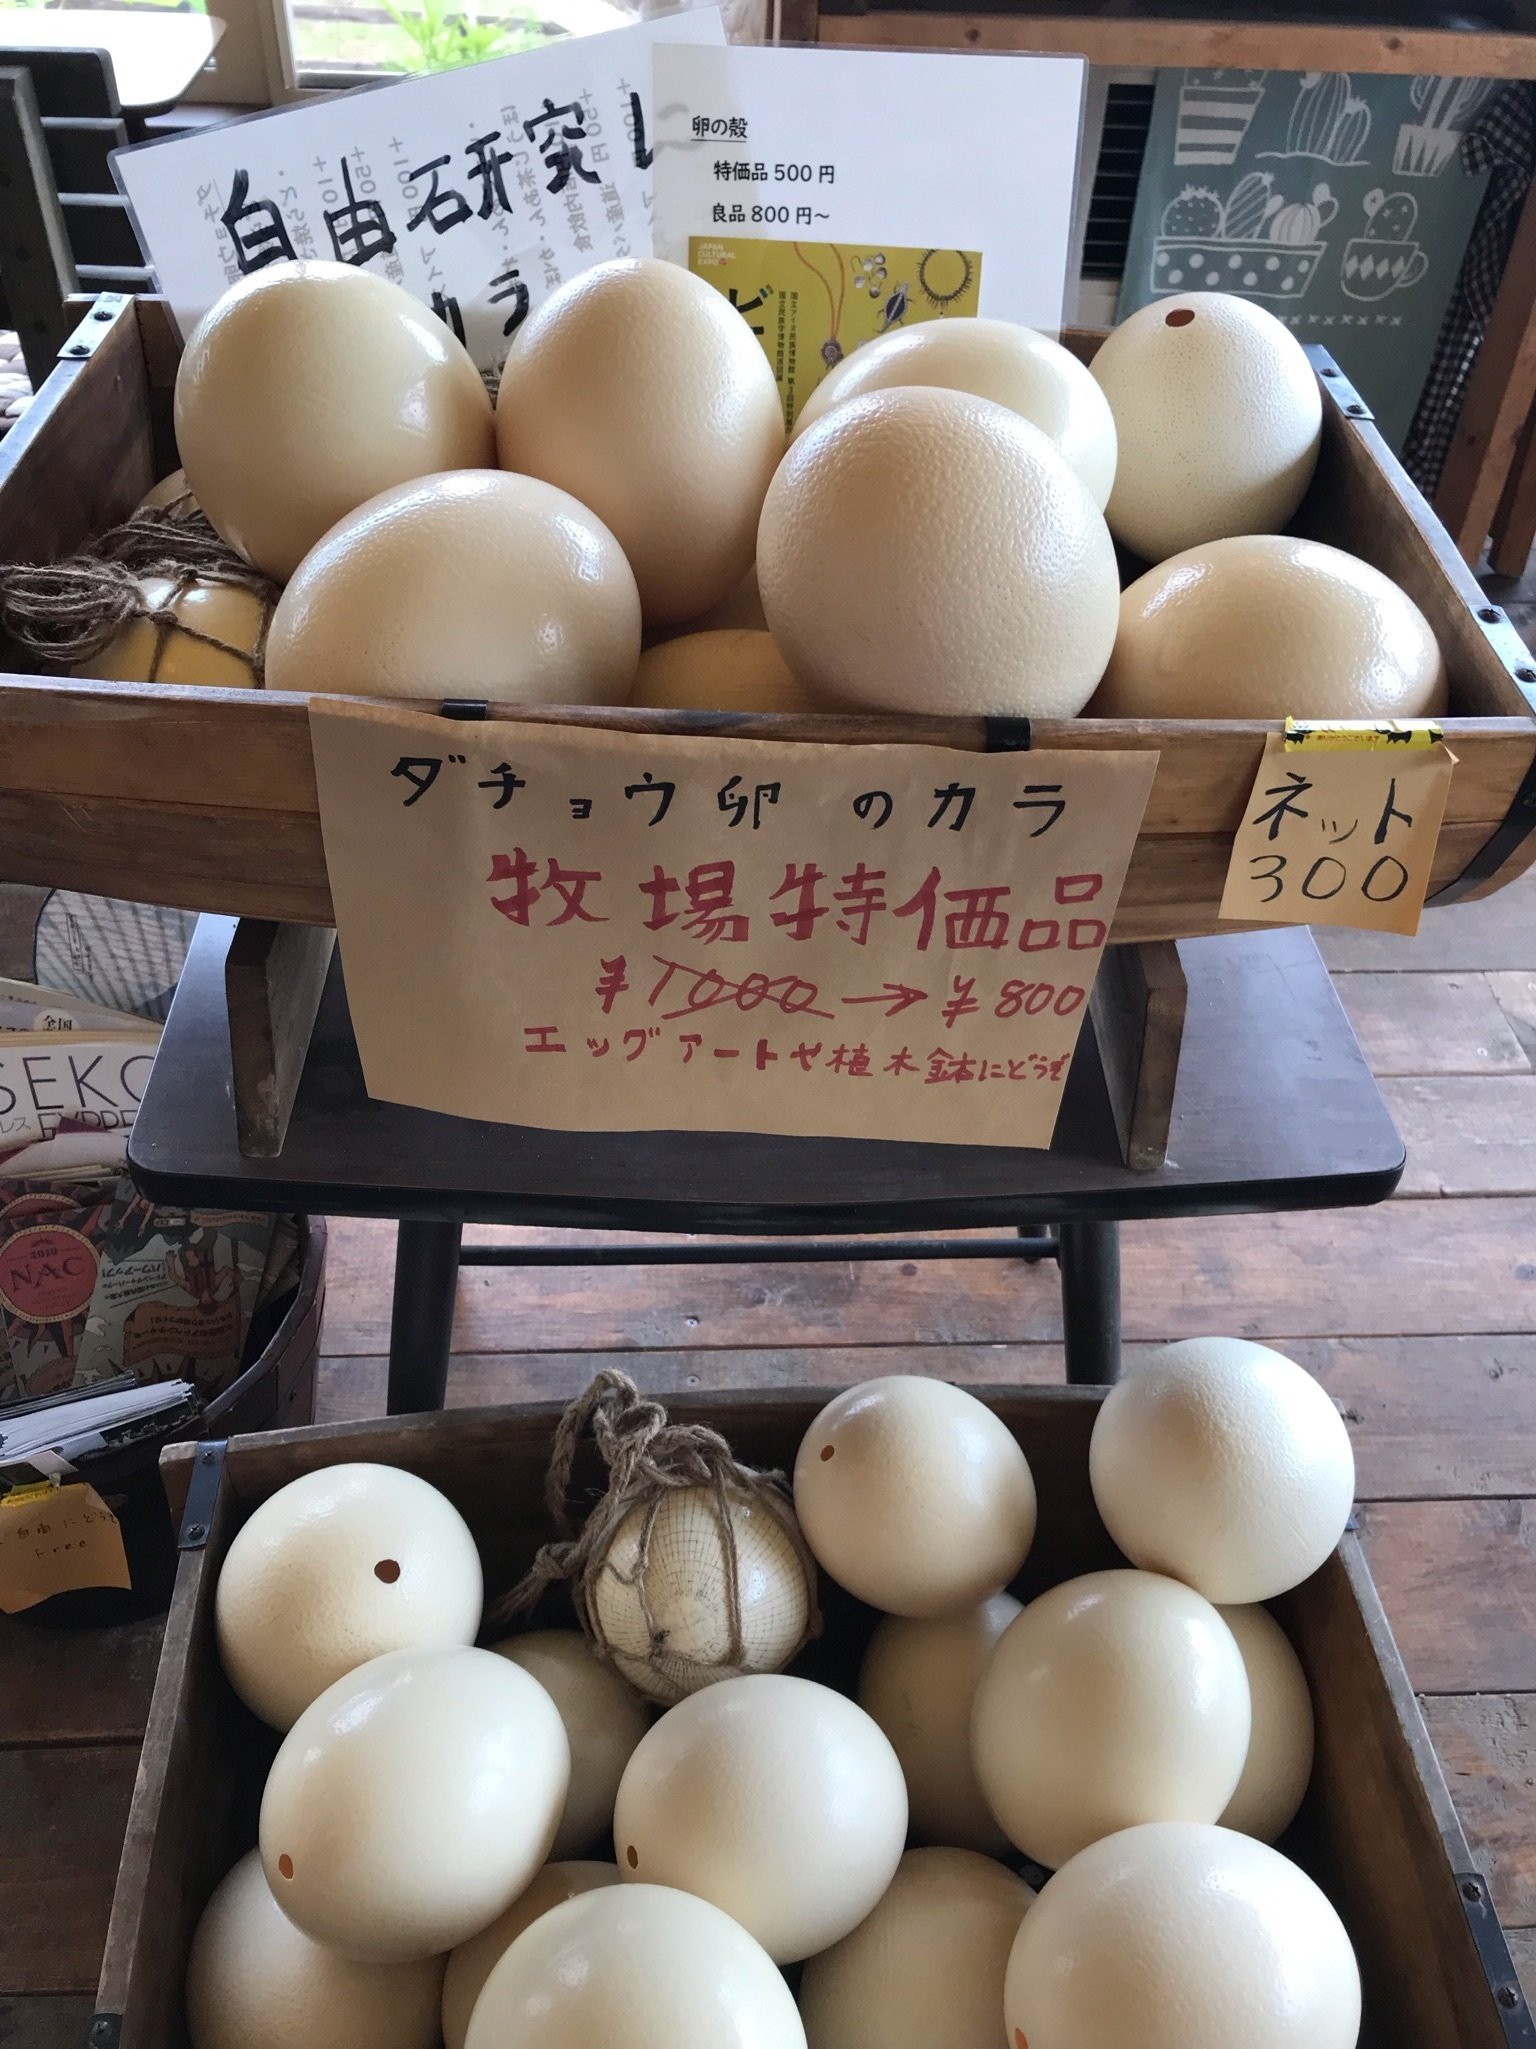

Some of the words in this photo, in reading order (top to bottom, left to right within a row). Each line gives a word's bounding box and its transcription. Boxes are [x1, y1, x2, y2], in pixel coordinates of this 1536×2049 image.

[692, 115, 748, 138] 卵の殻
[1252, 771, 1413, 845] ネット
[486, 847, 1108, 953] 牧場特価品
[1249, 854, 1408, 902] 300
[9, 1255, 86, 1293] NAC
